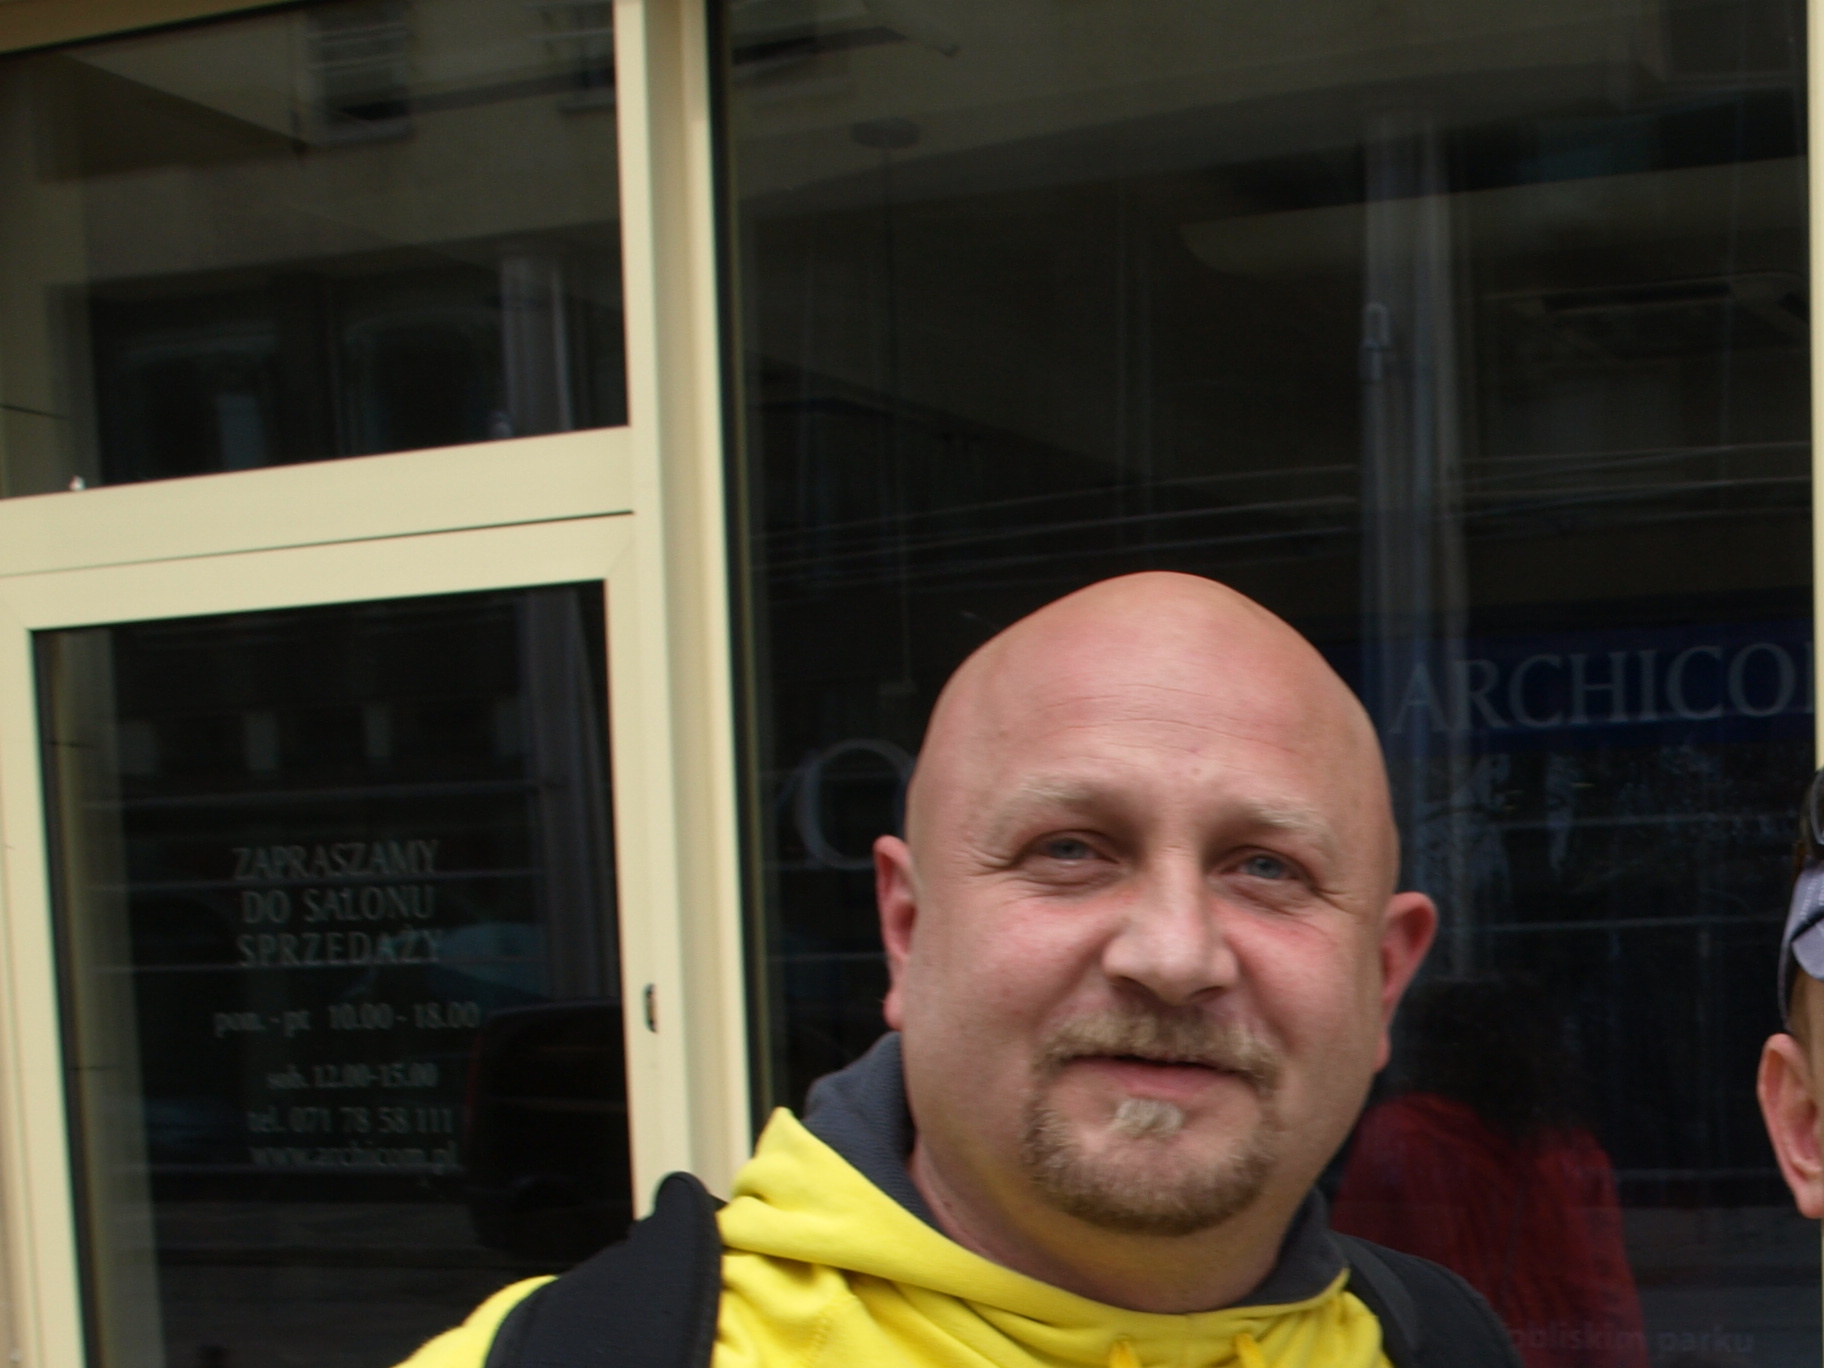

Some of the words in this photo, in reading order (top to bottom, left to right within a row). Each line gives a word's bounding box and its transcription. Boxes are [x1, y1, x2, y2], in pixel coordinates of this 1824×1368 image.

[232, 838, 438, 879] ZAPRASZAMY
[242, 890, 290, 923] DO
[304, 886, 435, 922] SALONU
[236, 924, 444, 966] SPRZEDAŻY
[328, 1002, 394, 1031] 10.00
[413, 1001, 481, 1030] 18.00
[339, 1105, 371, 1133] 78
[378, 1105, 409, 1133] 58
[415, 1106, 453, 1133] 111
[1503, 1320, 1649, 1352] obliskim
[1656, 1323, 1755, 1360] parku
